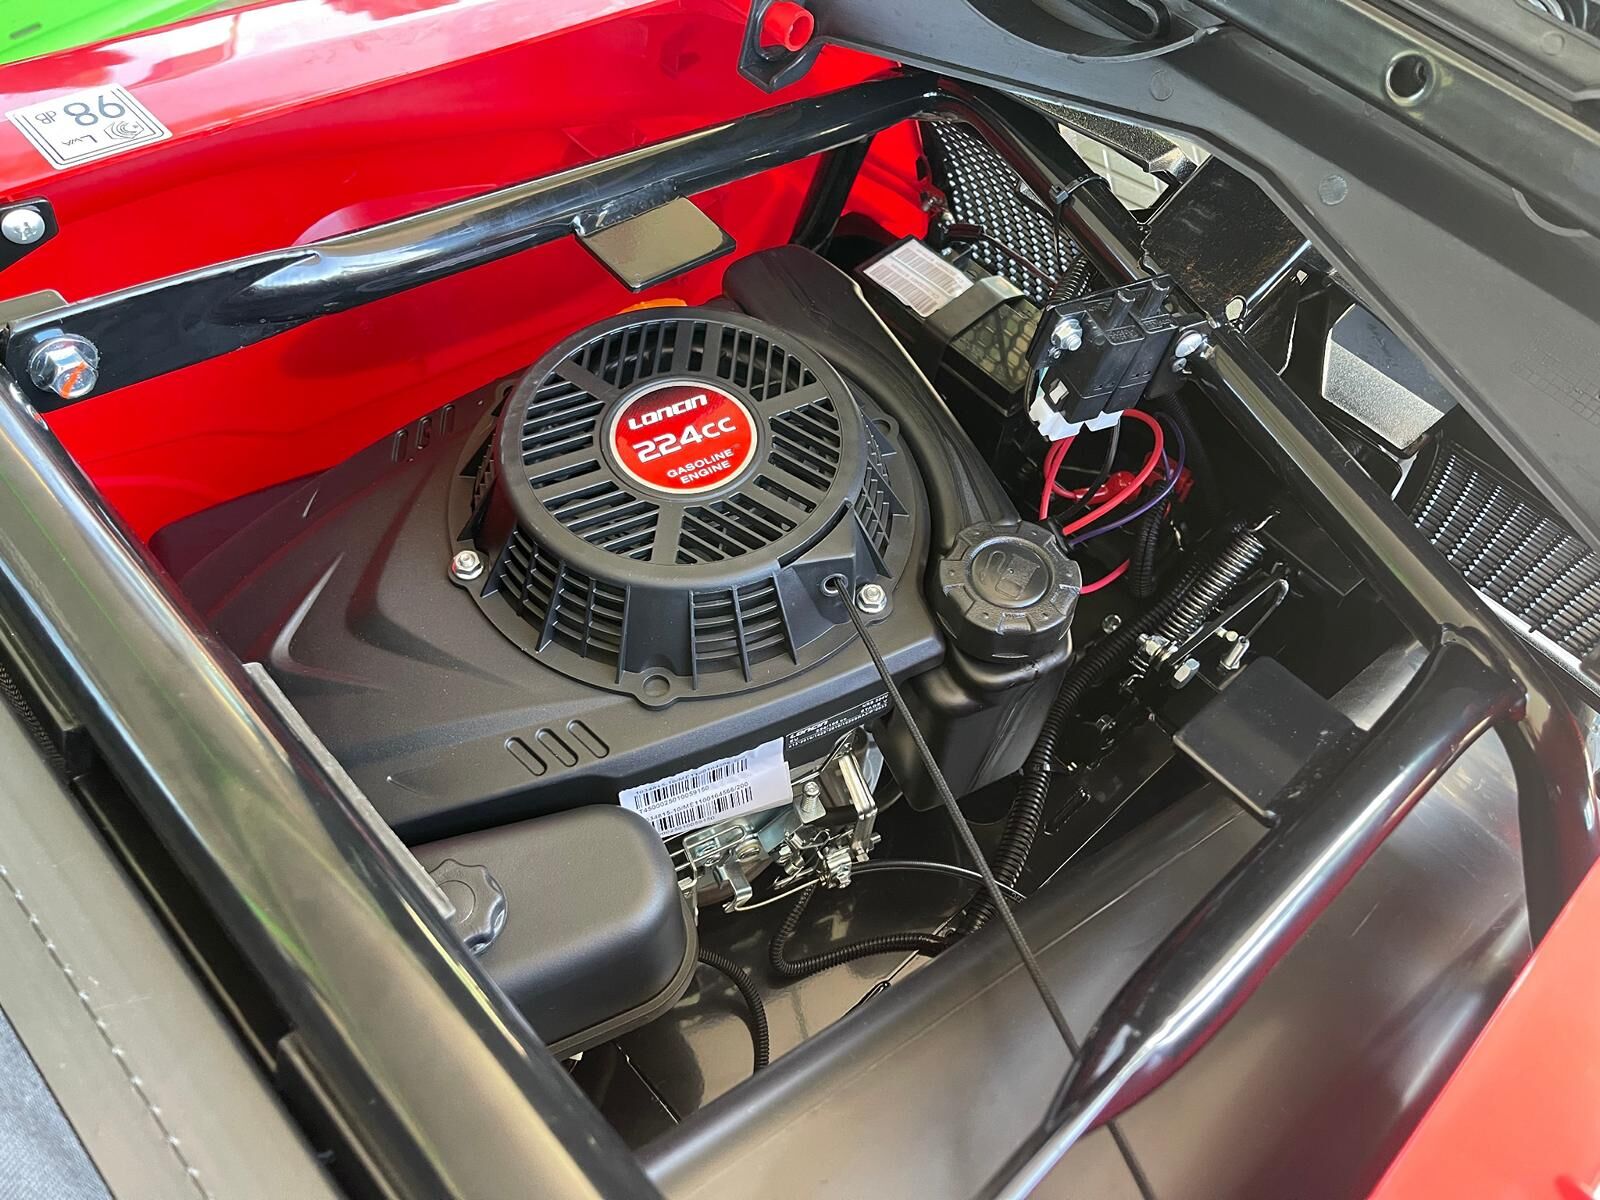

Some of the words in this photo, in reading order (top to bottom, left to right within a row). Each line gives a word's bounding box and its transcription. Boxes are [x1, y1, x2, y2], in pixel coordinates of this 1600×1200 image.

[35, 110, 57, 124] dB
[63, 95, 126, 126] 98
[666, 448, 734, 478] GASOLINE
[680, 460, 732, 485] ENGINE
